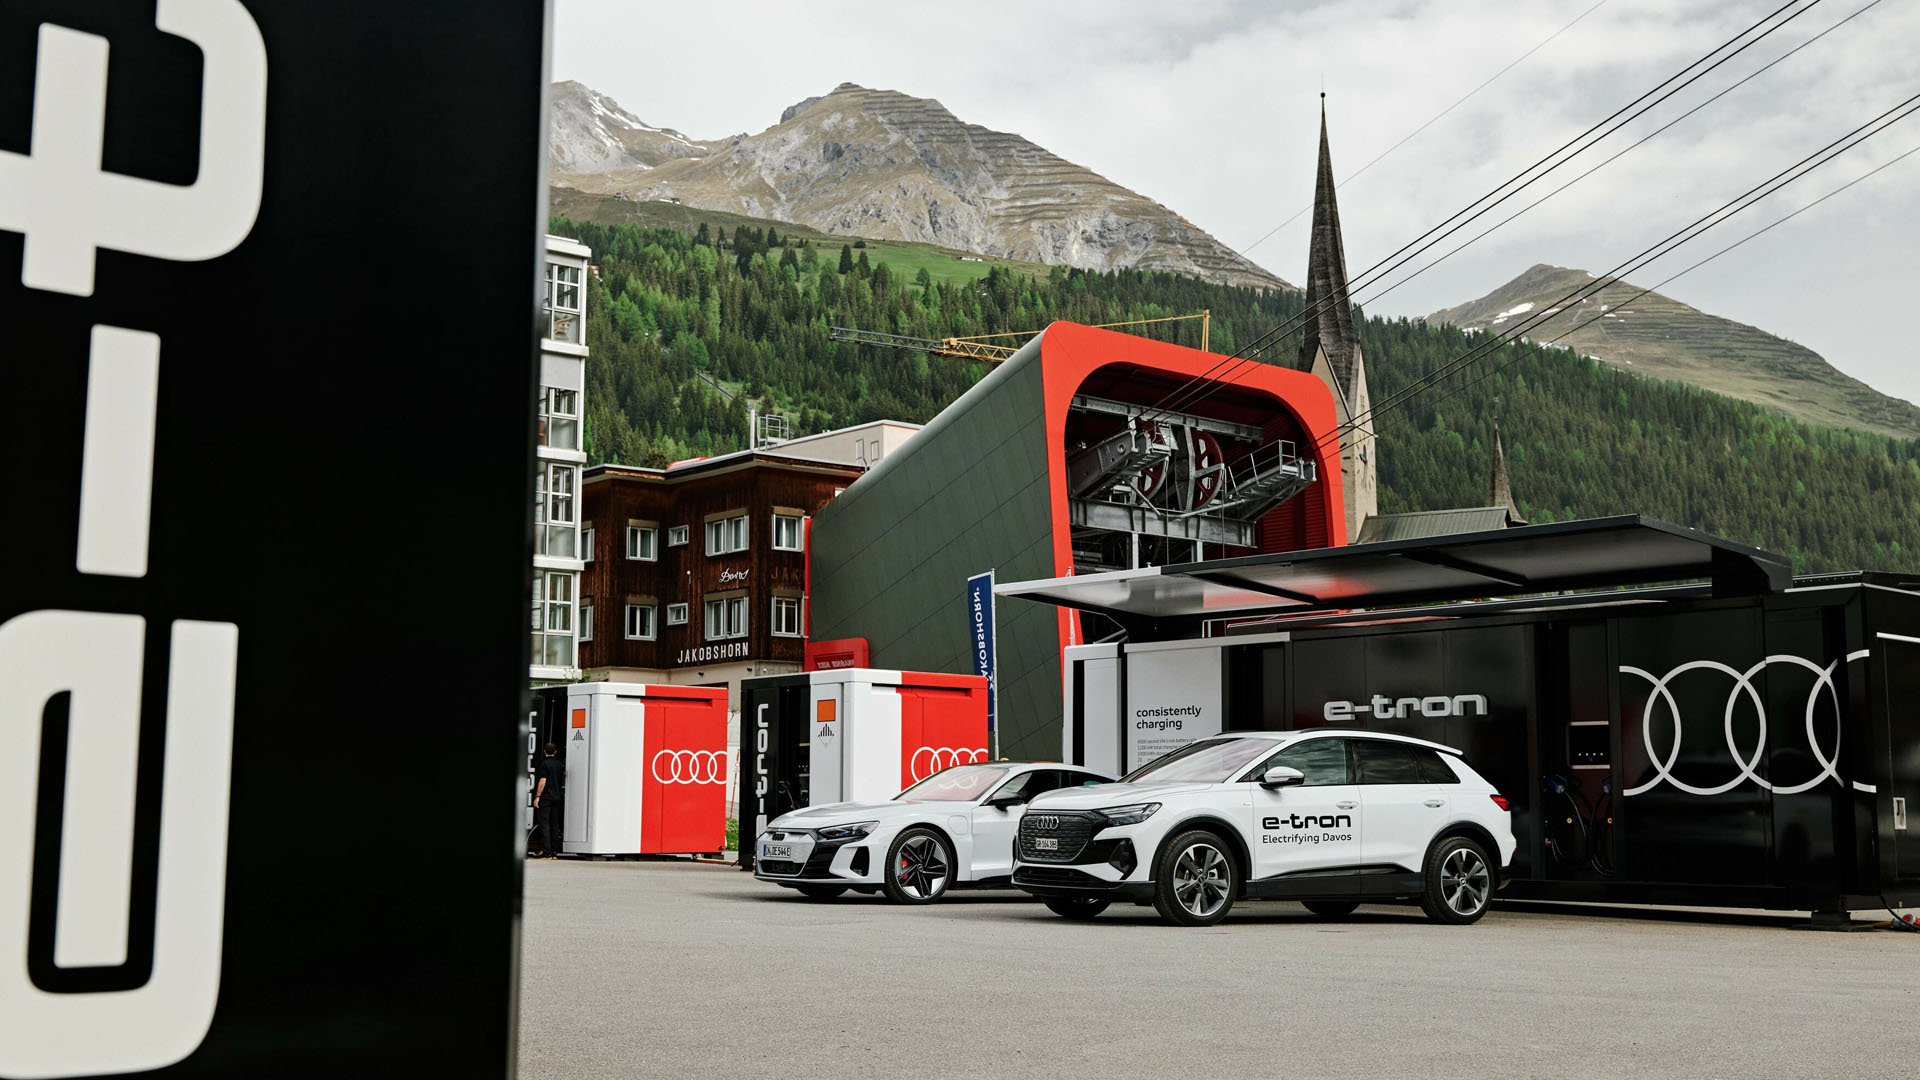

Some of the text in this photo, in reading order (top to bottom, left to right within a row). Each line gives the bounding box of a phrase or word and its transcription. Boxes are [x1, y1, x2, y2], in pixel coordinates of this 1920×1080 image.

[677, 642, 749, 664] JAKOBSHORN
[1136, 705, 1202, 718] consistently
[1323, 694, 1488, 721] e-tron
[1136, 718, 1183, 731] charging
[1262, 813, 1351, 830] e-tron
[1262, 833, 1352, 845] Electrifying Davos
